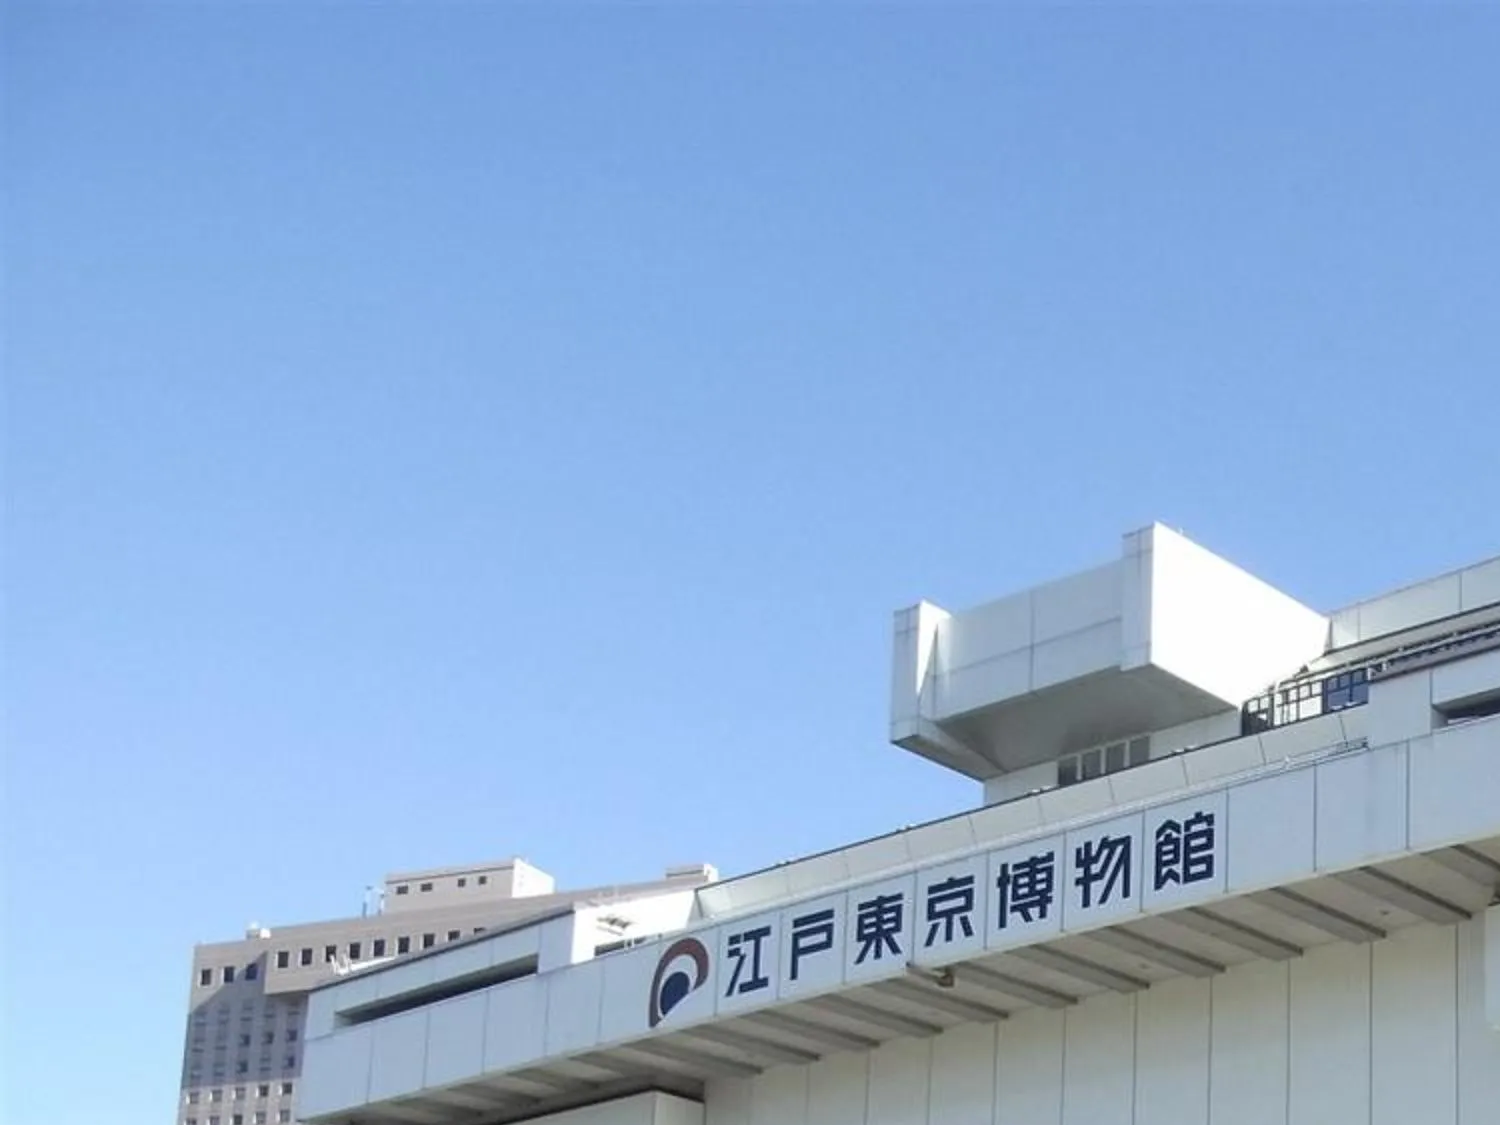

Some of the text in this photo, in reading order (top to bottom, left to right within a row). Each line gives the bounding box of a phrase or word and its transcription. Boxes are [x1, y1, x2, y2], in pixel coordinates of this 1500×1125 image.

[725, 811, 1215, 997] 江戸東京博物館
